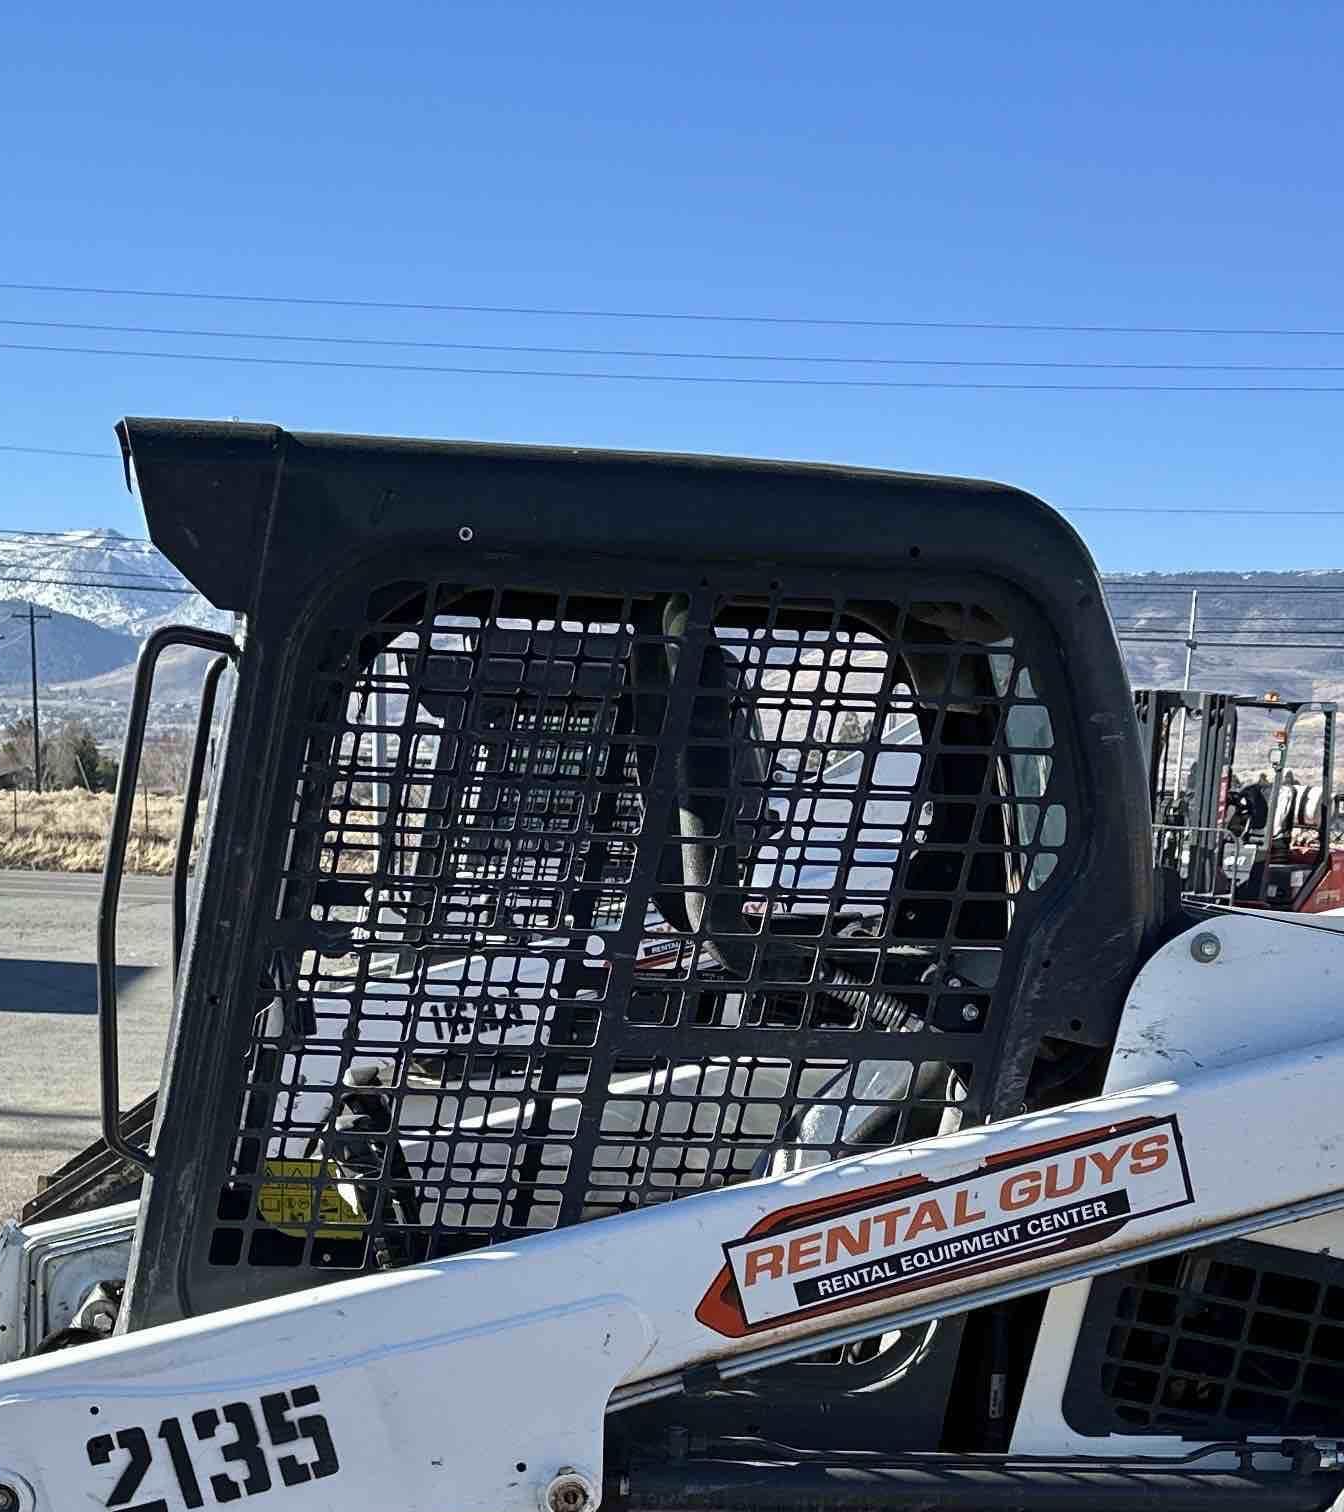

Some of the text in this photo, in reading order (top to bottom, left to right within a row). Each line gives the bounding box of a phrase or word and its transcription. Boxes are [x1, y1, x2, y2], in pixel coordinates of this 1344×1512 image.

[744, 1133, 1170, 1287] RENTAL GUYS
[817, 1199, 1109, 1296] RENTAL EQUIPMENT CENTER
